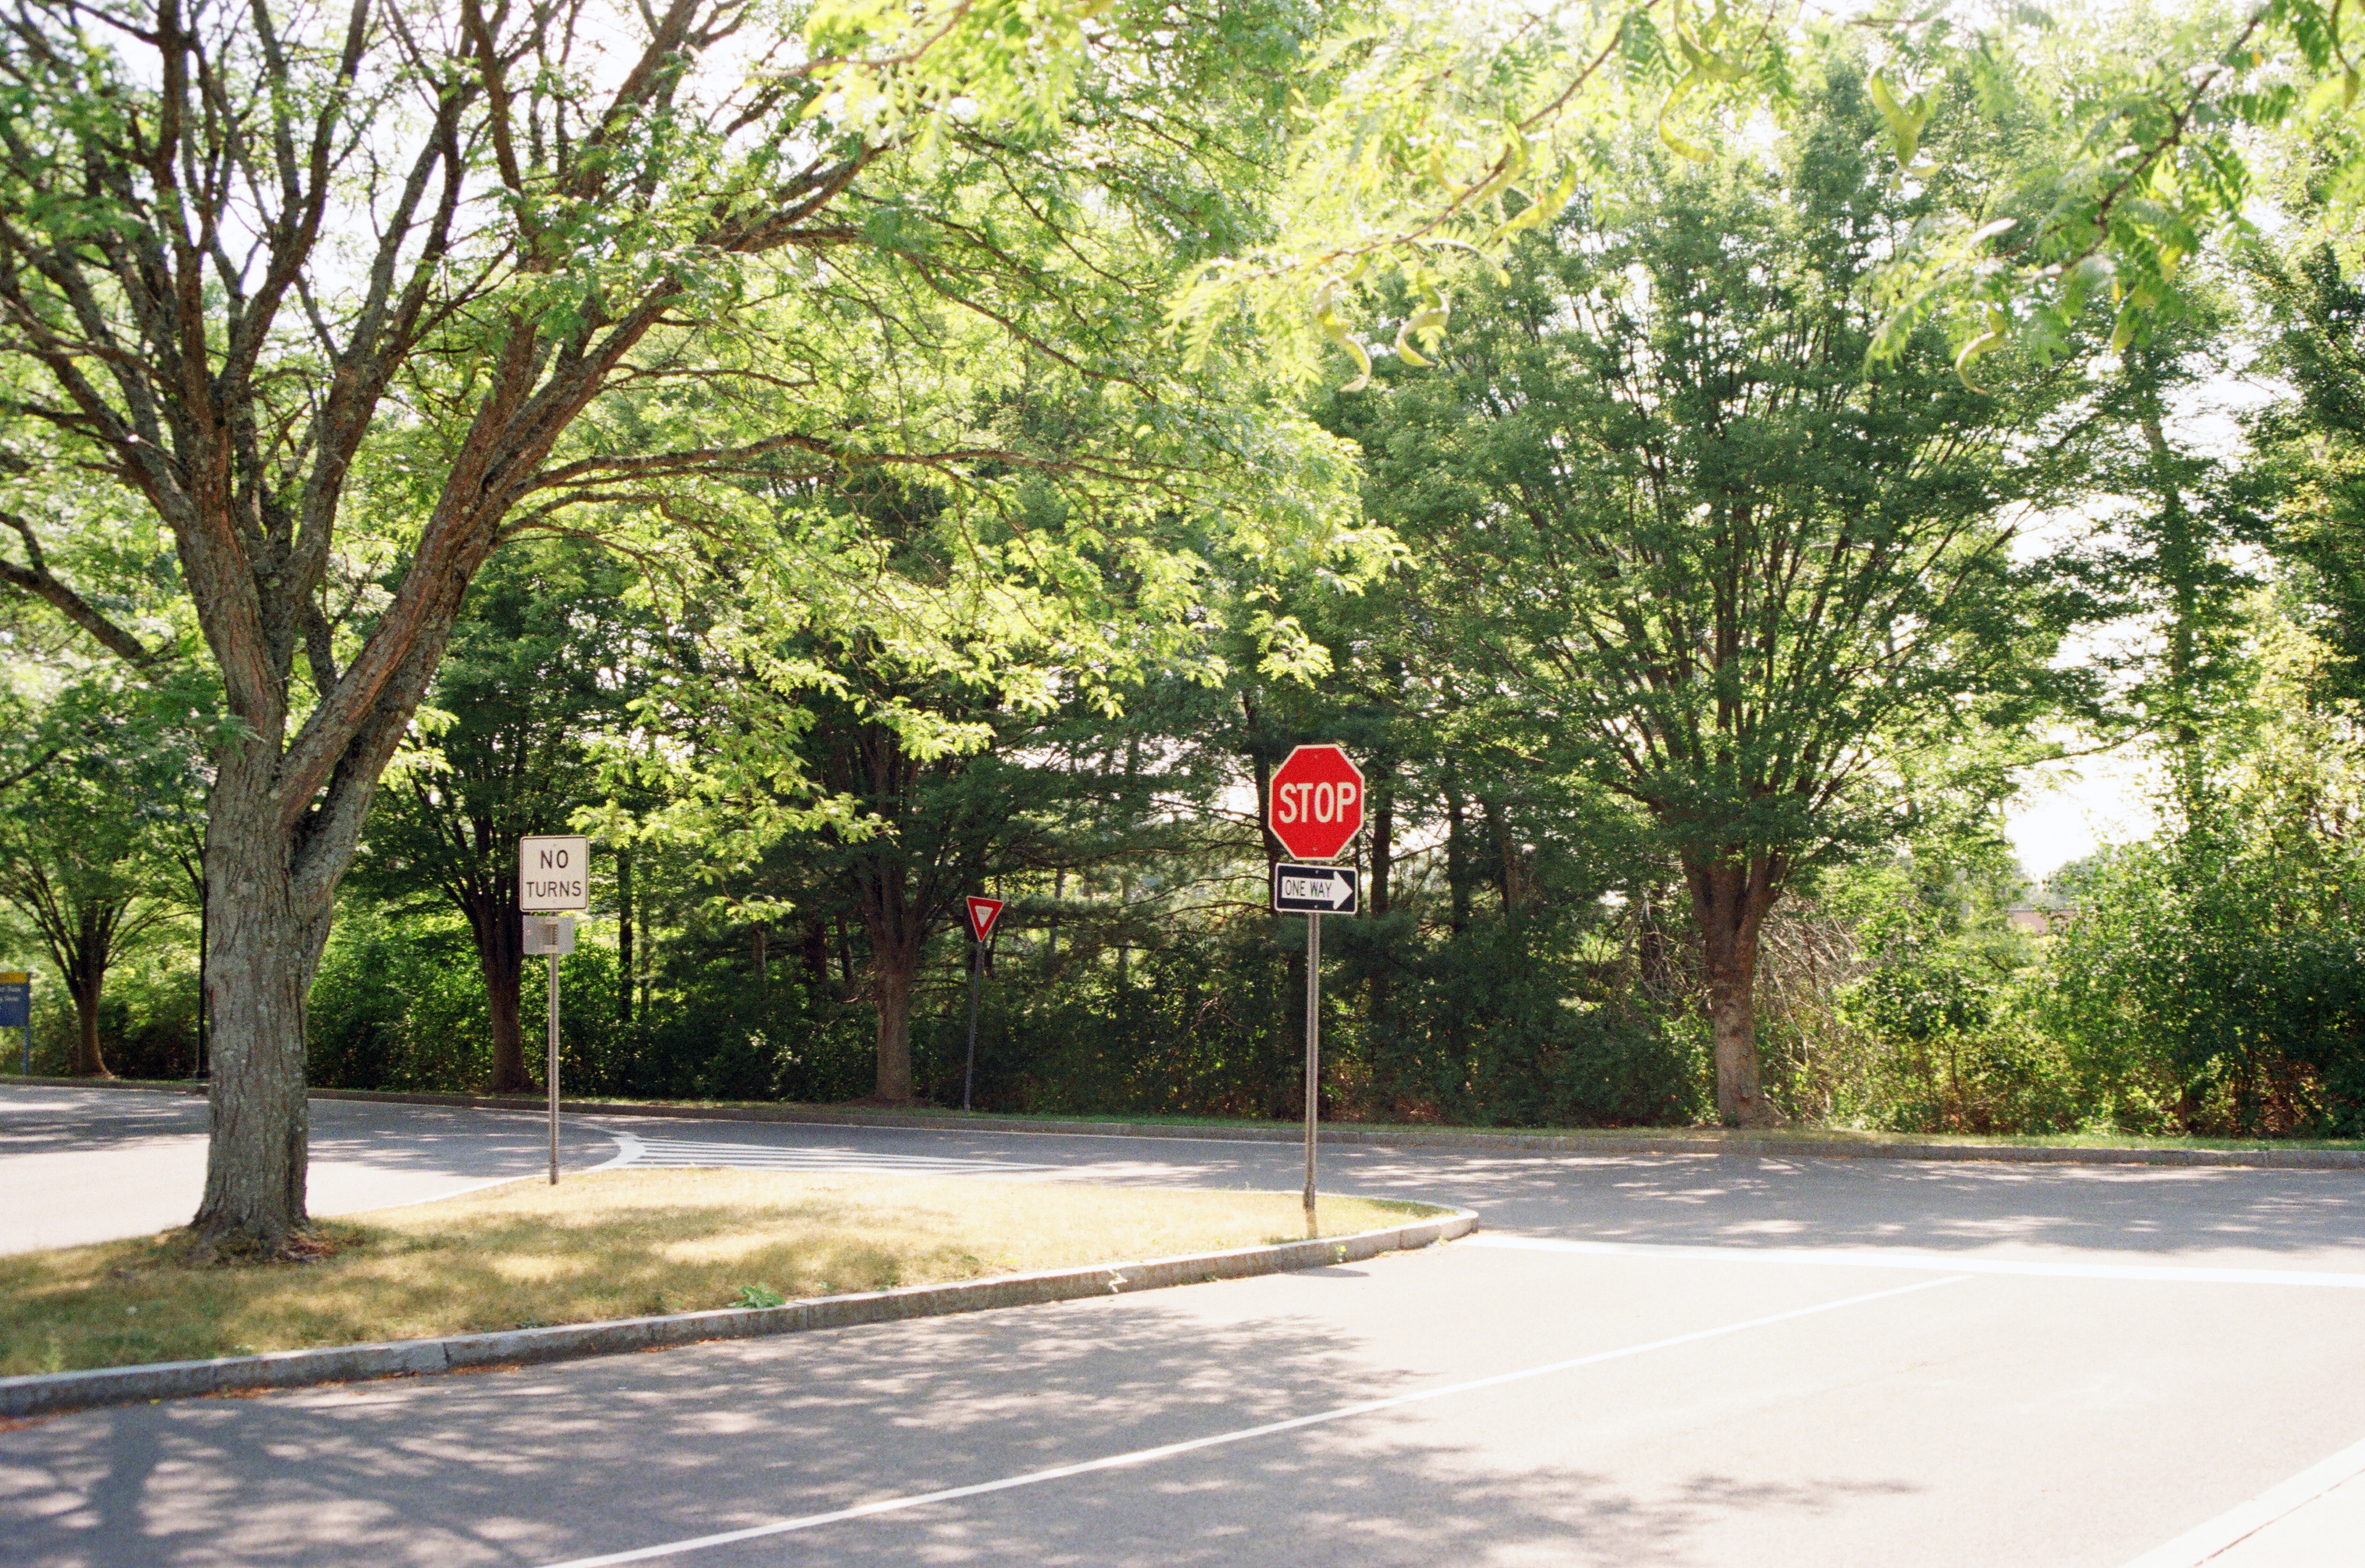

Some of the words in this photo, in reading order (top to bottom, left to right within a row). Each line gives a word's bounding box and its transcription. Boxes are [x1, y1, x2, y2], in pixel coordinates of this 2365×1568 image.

[1279, 782, 1357, 823] STOP
[541, 849, 568, 869] NO
[526, 881, 581, 897] TURNS
[1285, 879, 1306, 897] ONE
[1310, 881, 1332, 898] WAY
